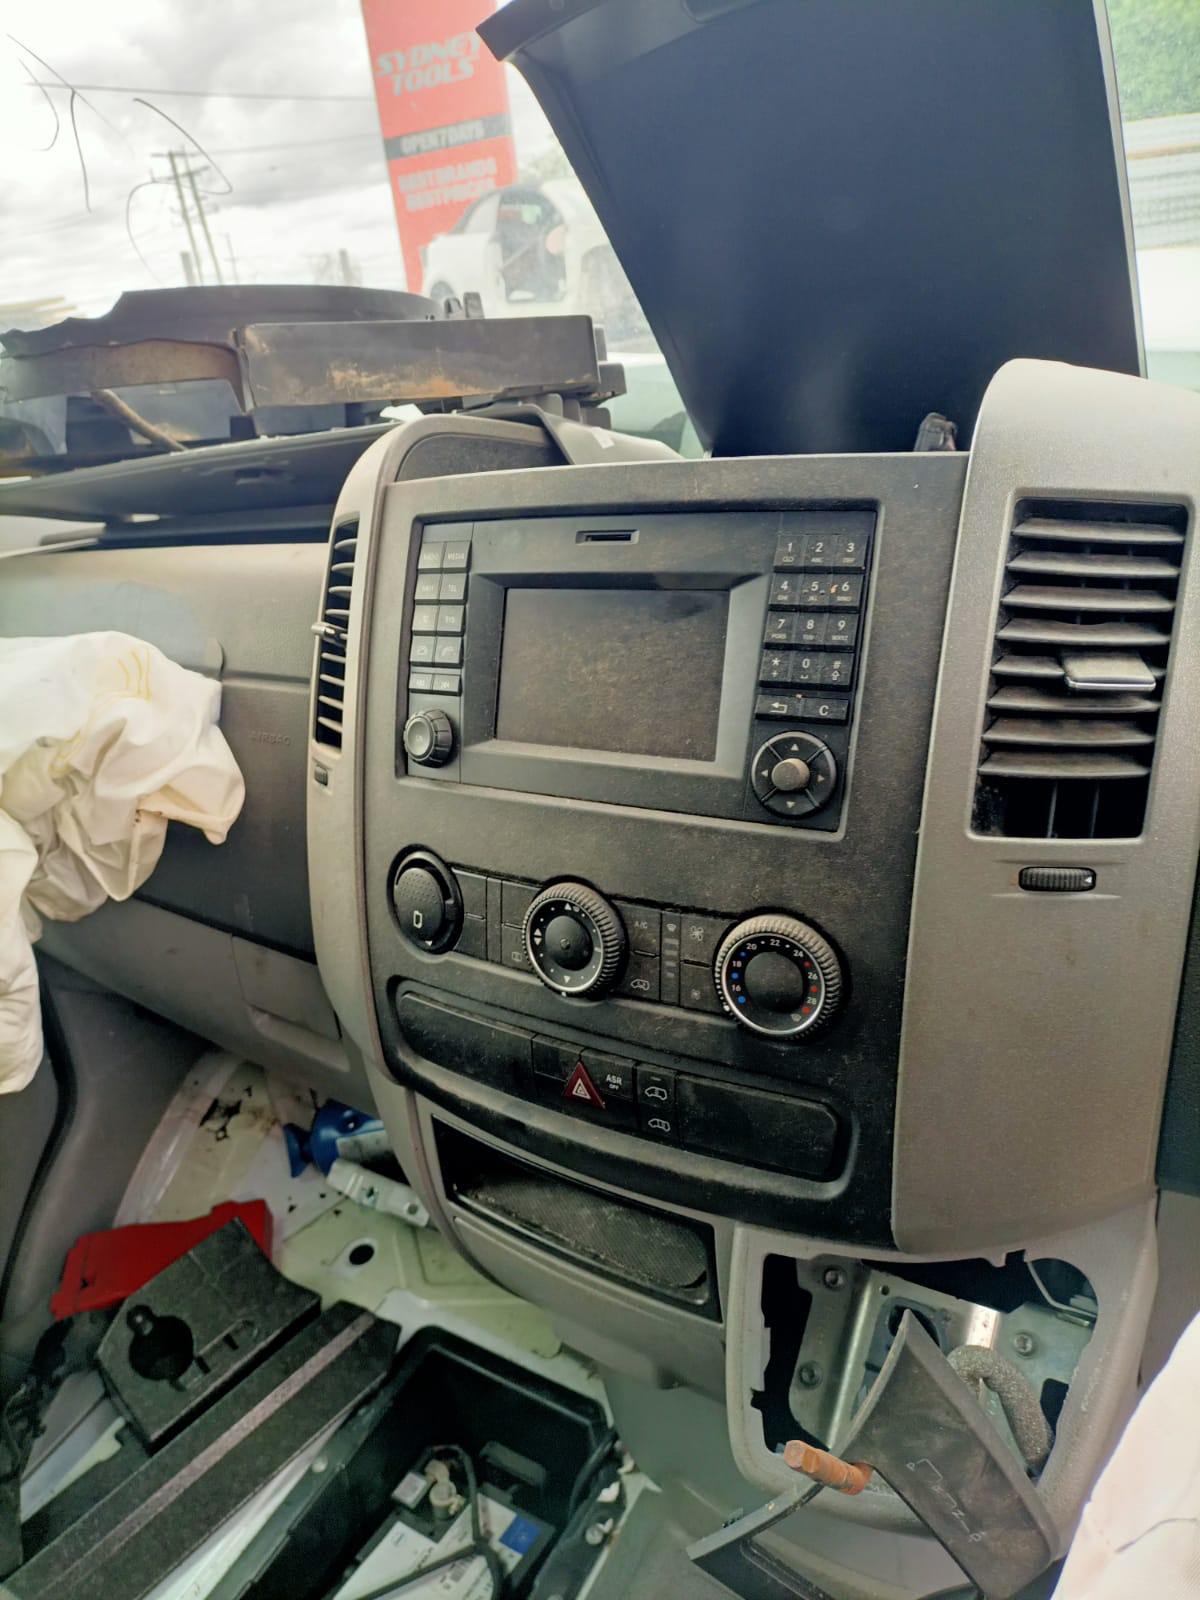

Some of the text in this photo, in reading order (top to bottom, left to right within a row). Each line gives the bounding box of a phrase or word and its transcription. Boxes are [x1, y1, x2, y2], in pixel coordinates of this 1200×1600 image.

[377, 33, 480, 75] SYDNEY
[393, 58, 475, 95] TOOLS
[788, 542, 793, 552] 1
[815, 542, 824, 552] 2
[846, 542, 855, 553] 3
[780, 581, 789, 591] 4
[811, 581, 819, 592] 5
[842, 581, 850, 592] 6
[777, 618, 786, 629] 7
[806, 619, 815, 630] 8
[838, 620, 846, 631] 9
[802, 658, 810, 669] 0
[818, 704, 830, 717] C
[634, 918, 648, 929] A/C
[746, 943, 758, 951] 20
[769, 938, 781, 947] 22
[792, 949, 805, 958] 24
[732, 960, 743, 968] 18
[807, 971, 819, 980] 26
[731, 984, 742, 992] 16
[605, 1073, 623, 1087] ASR
[906, 1462, 915, 1471] P
